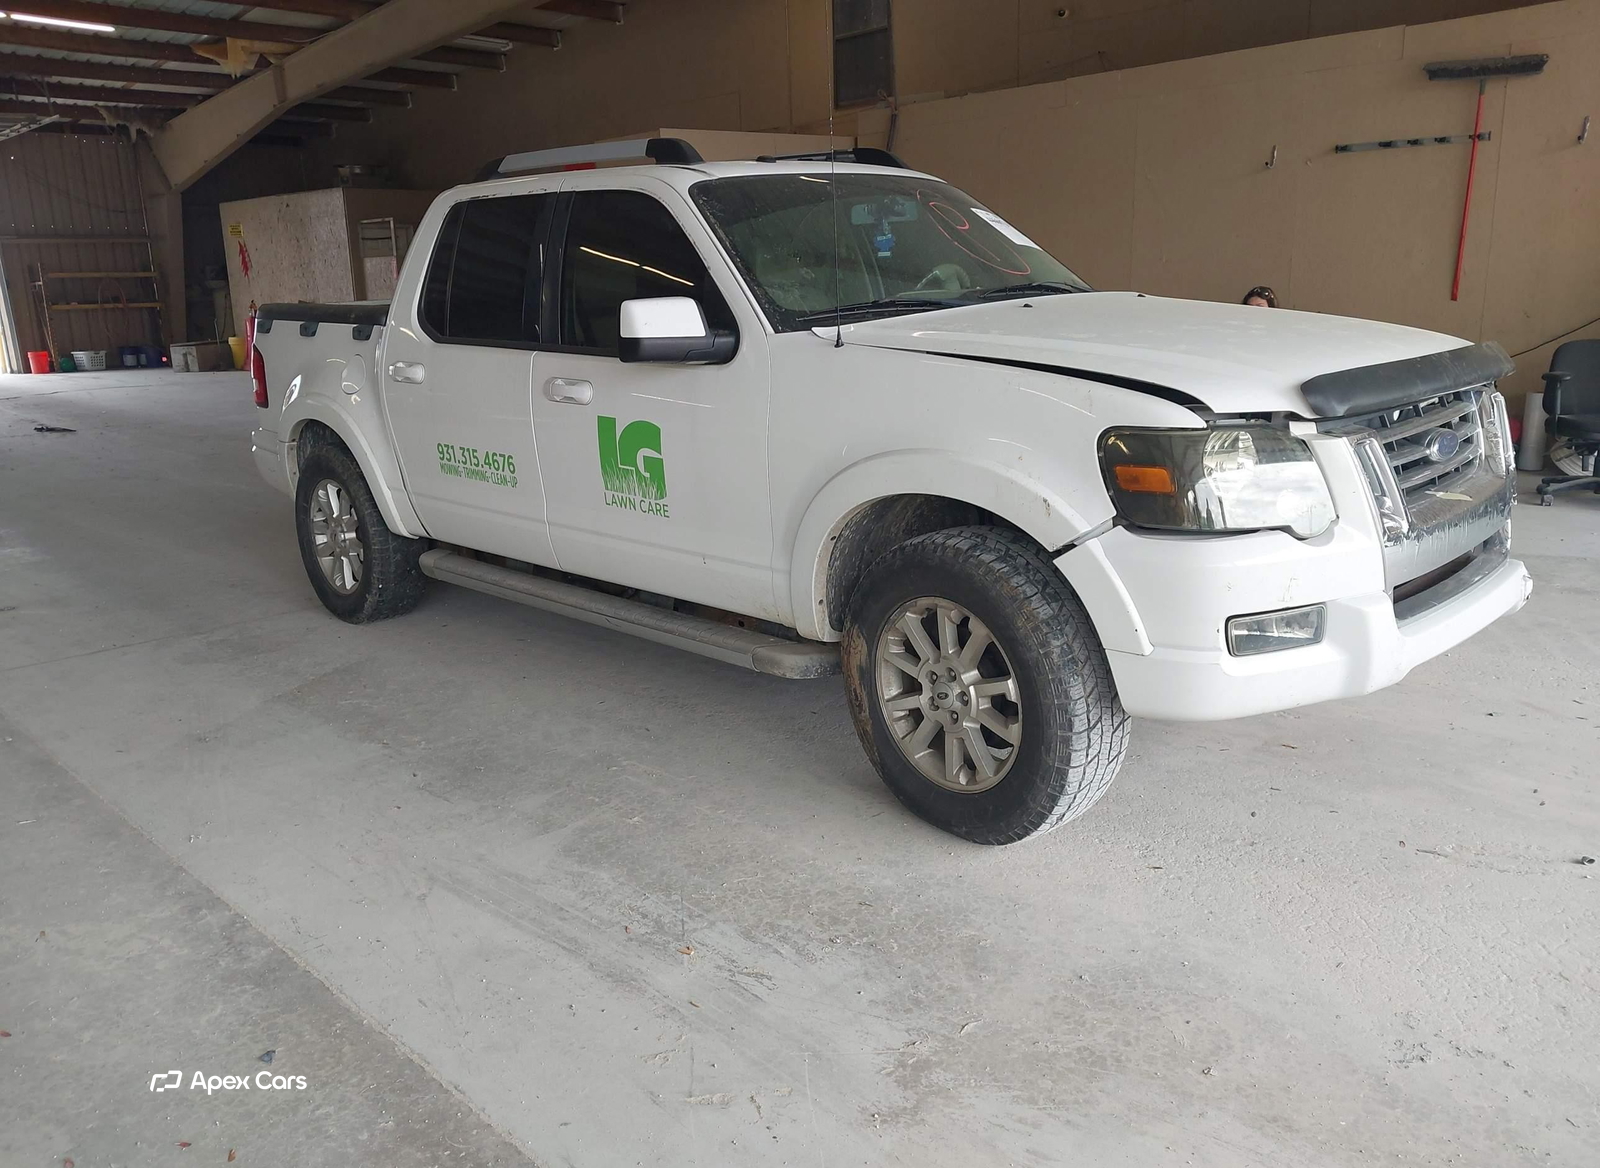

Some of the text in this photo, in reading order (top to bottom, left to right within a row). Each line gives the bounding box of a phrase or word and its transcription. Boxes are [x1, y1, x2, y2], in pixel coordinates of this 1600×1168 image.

[437, 443, 516, 475] 931.315.4676
[597, 414, 667, 500] LG
[604, 491, 670, 518] LAWN CARE
